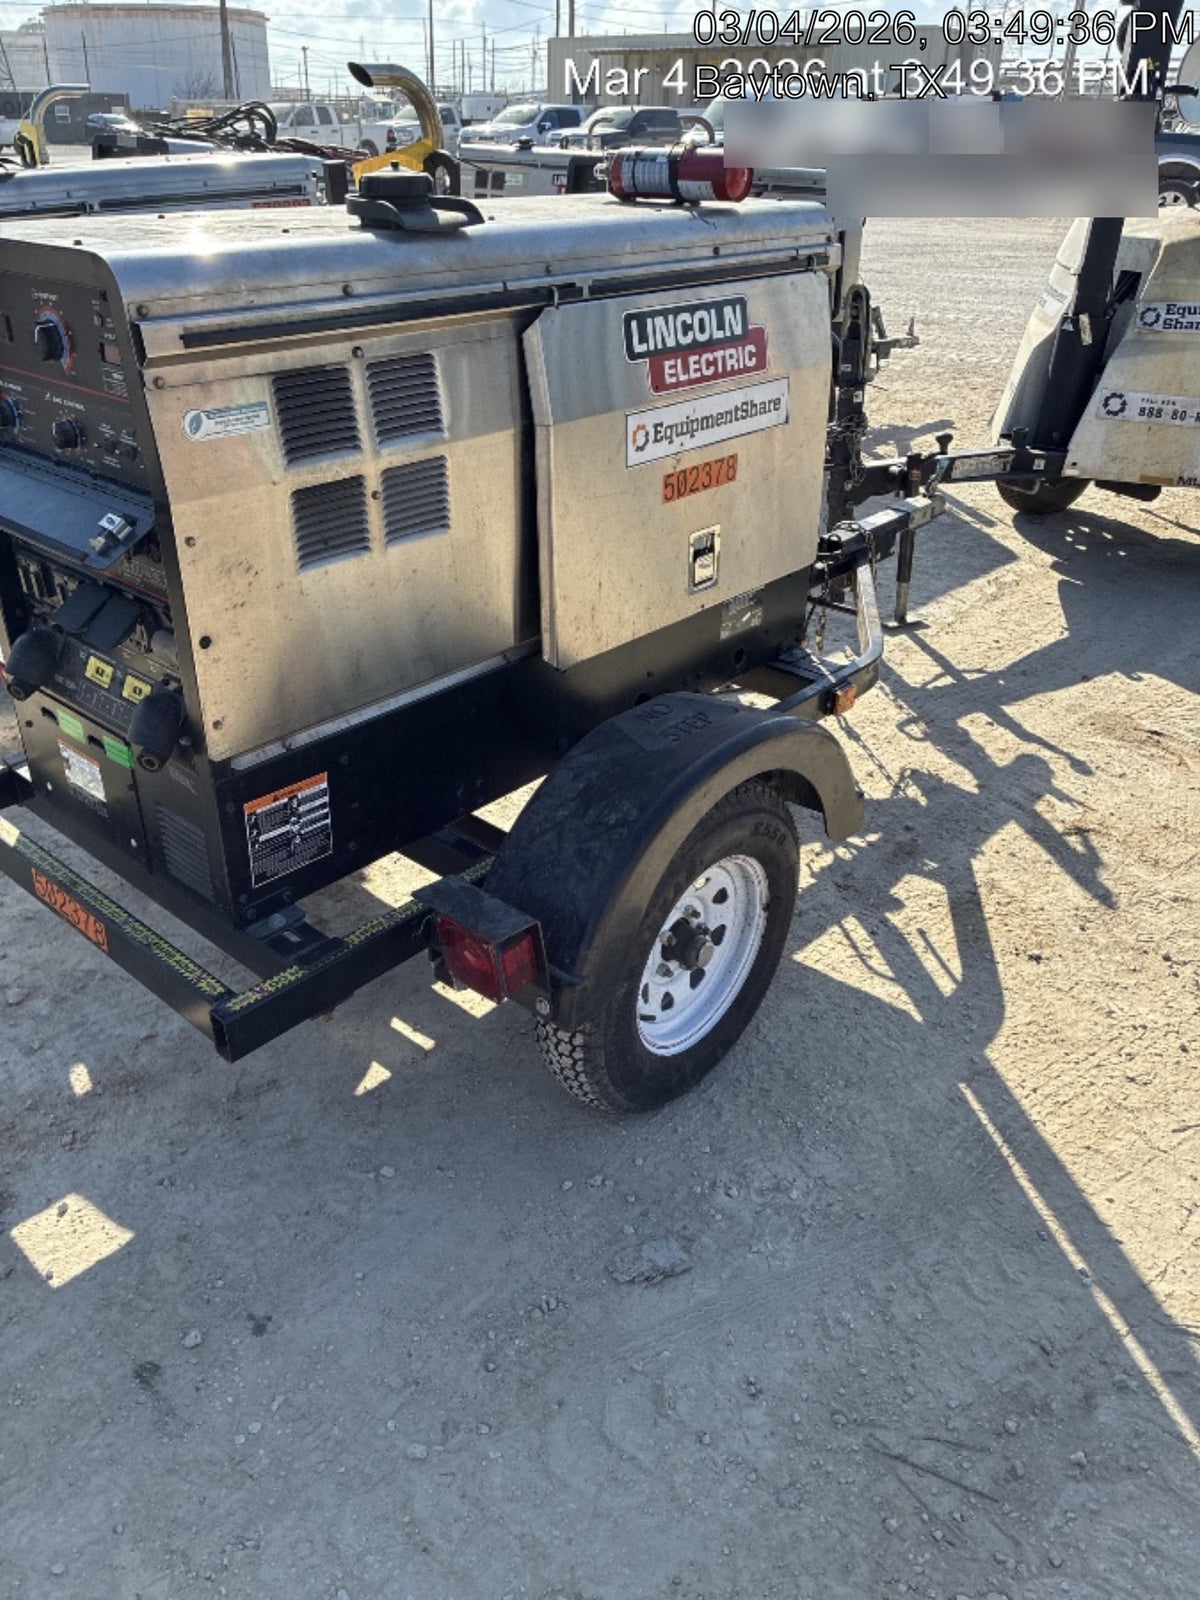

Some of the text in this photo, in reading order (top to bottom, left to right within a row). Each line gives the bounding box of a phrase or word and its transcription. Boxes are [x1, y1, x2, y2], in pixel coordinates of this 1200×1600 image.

[630, 303, 743, 353] LINCOLN
[663, 344, 757, 384] ELECTRIC
[652, 396, 782, 445] EquipmentShare
[663, 455, 738, 502] 502378
